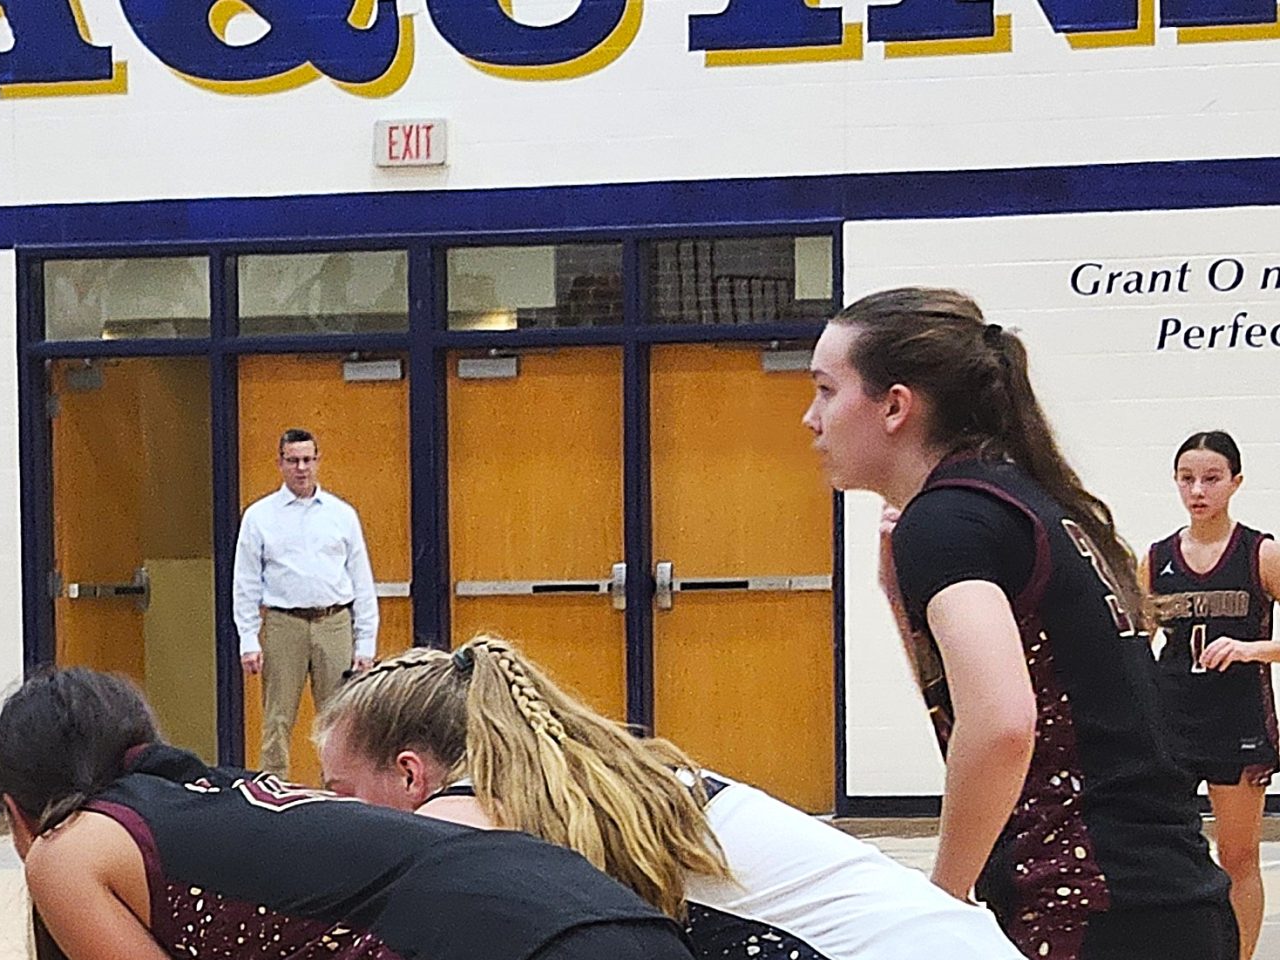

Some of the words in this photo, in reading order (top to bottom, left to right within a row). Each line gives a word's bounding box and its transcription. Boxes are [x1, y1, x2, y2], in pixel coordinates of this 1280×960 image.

[388, 124, 434, 160] EXIT
[1070, 261, 1192, 296] Grant
[1208, 258, 1244, 292] O
